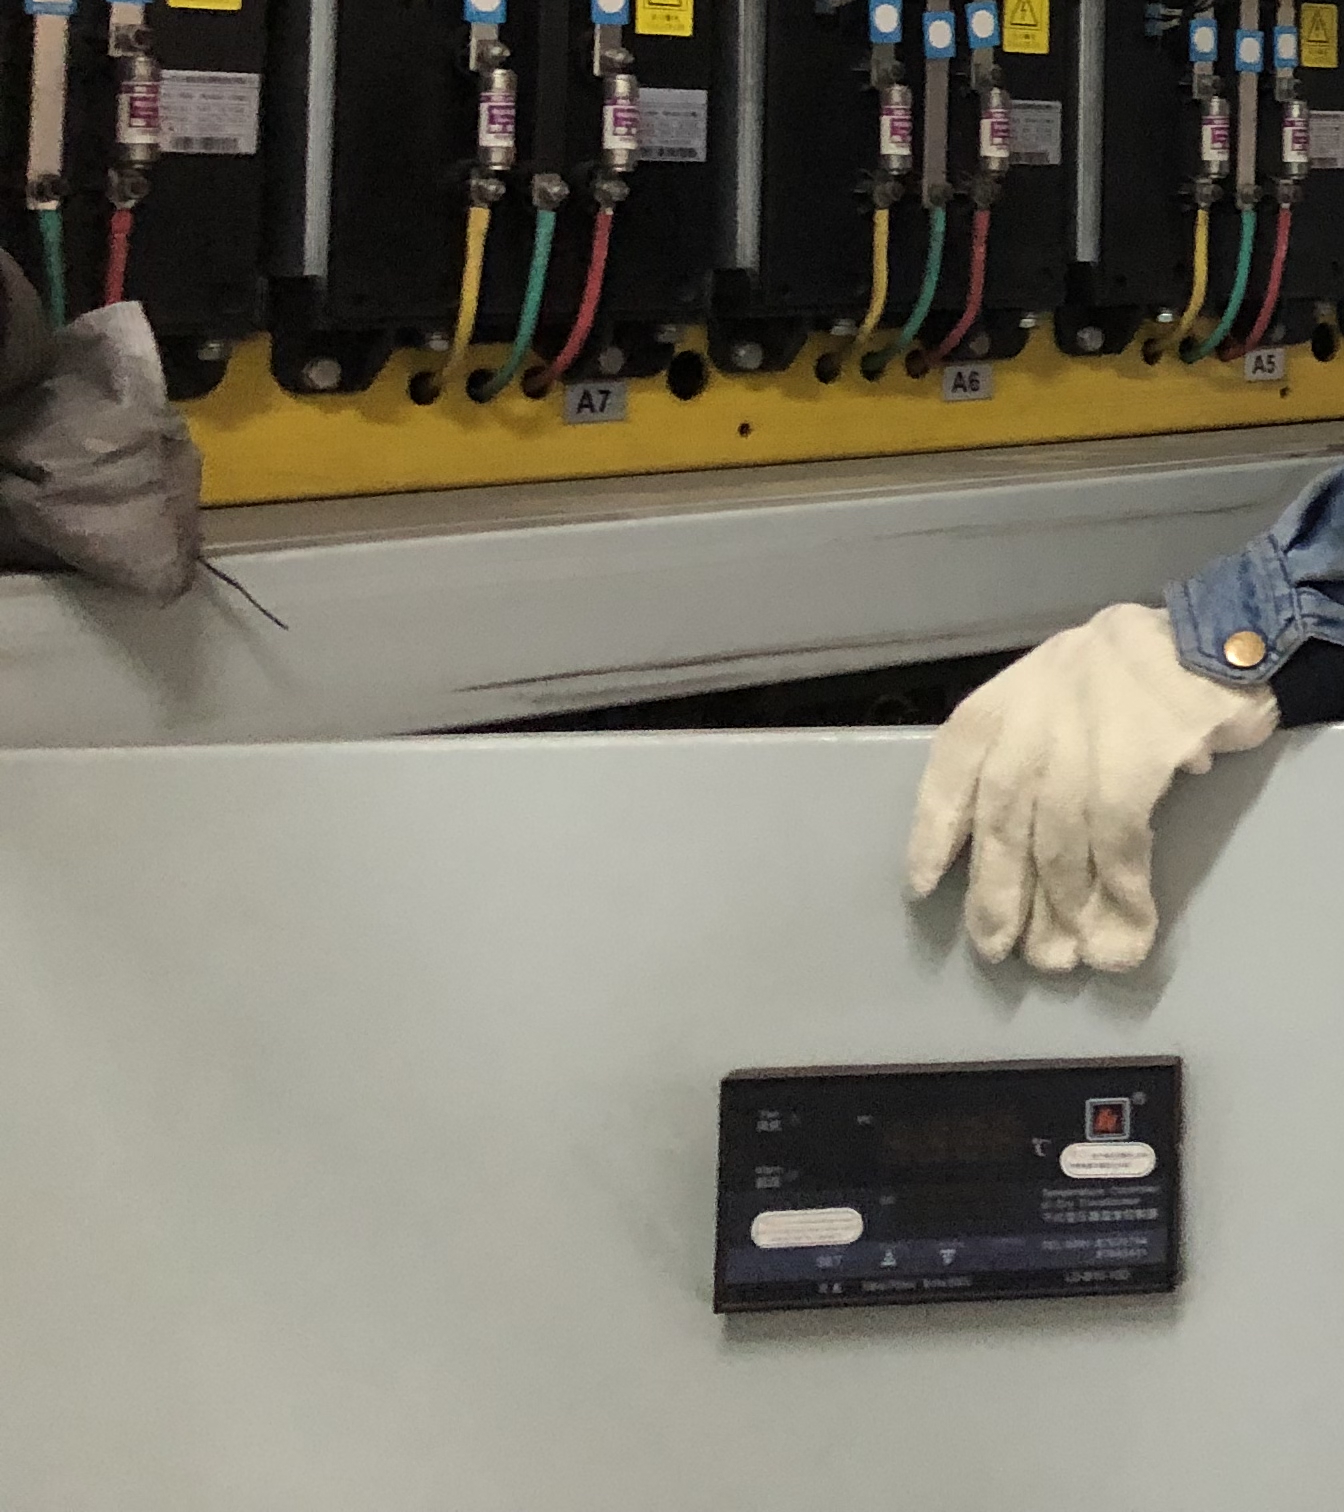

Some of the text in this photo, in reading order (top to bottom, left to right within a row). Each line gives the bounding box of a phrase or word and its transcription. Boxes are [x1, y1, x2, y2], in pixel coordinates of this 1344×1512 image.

[1252, 354, 1275, 374] A5
[951, 371, 981, 393] A6
[576, 389, 612, 414] A7
